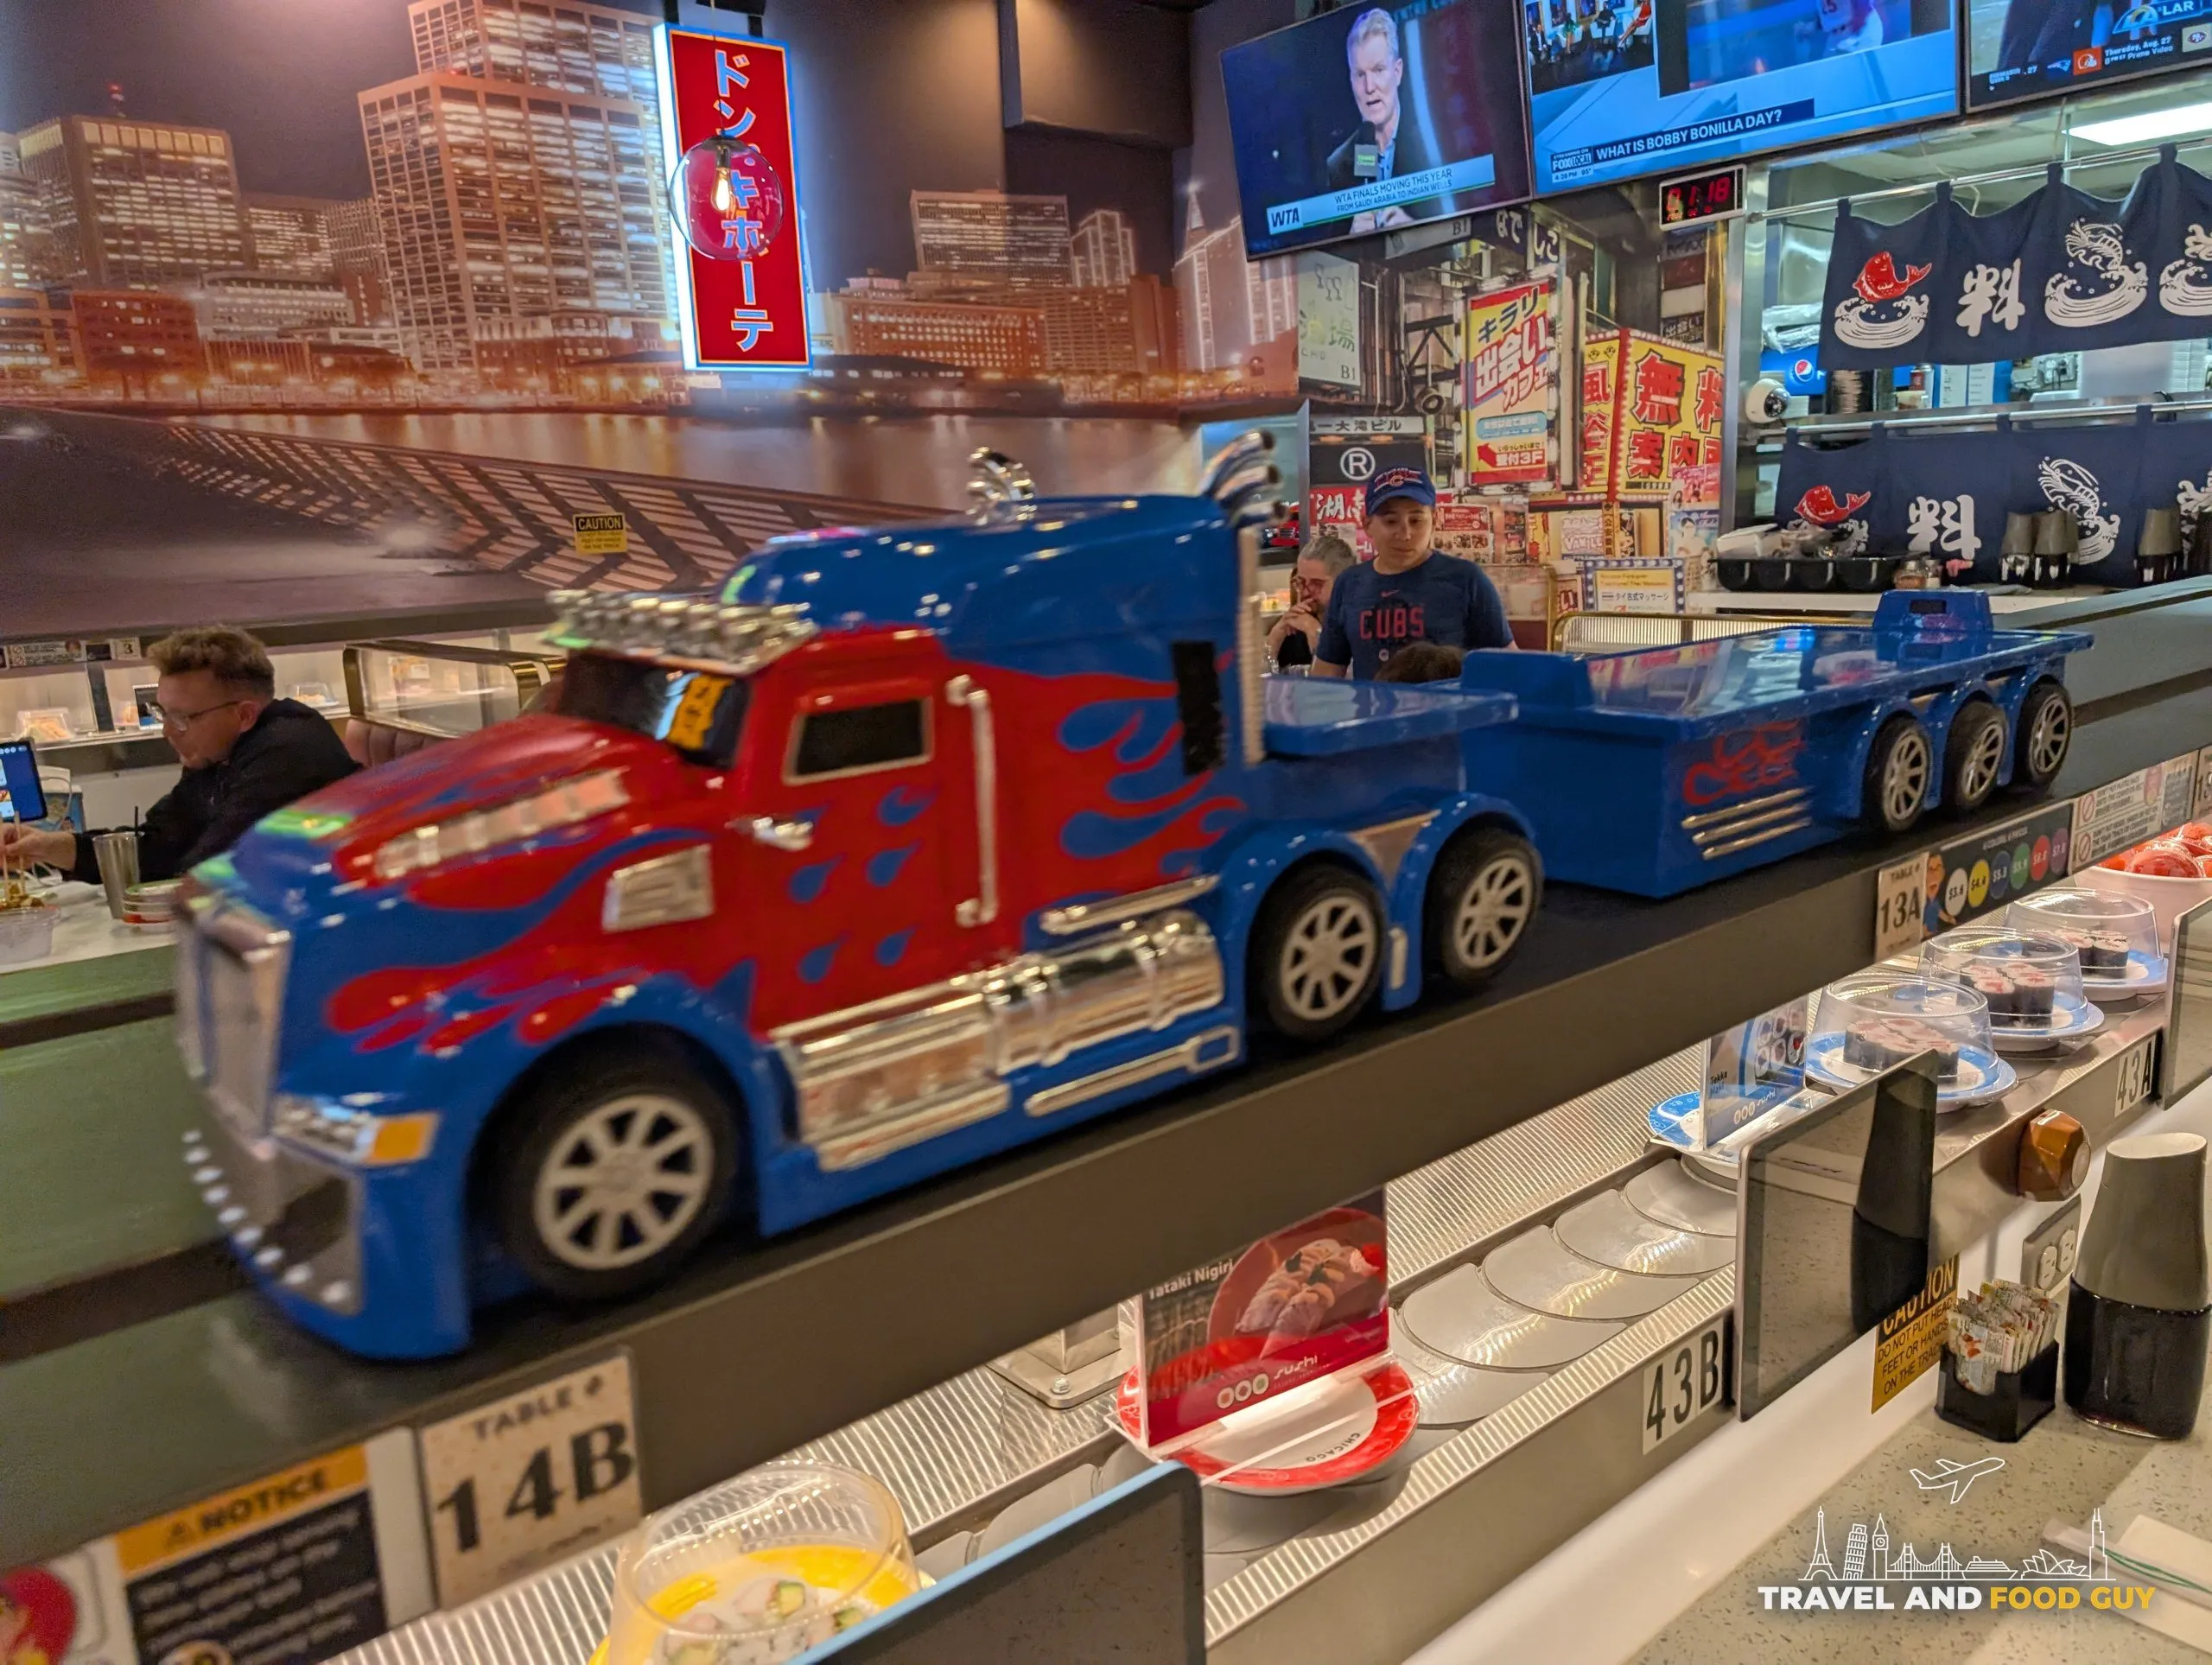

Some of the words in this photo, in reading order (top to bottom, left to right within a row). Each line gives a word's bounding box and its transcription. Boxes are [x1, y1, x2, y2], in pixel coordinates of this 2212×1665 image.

[2162, 0, 2195, 16] LAR
[1596, 143, 1631, 161] WHAT
[1632, 139, 1645, 153] IS
[1646, 130, 1688, 149] BOBBY
[1690, 118, 1743, 141] BONILLA
[1745, 109, 1783, 129] DAY?
[1334, 191, 1352, 204] WTA
[1353, 186, 1379, 201] FINALS
[1380, 178, 1411, 193] MOVING
[1413, 174, 1430, 185] THIS
[1431, 168, 1452, 181] YEAR
[1552, 158, 1572, 171] FOX
[1271, 207, 1300, 228] WTA
[1337, 202, 1355, 213] FROM
[1355, 199, 1373, 208] SAUDI
[1374, 194, 1396, 205] ARABIA
[1408, 186, 1430, 196] INDIAN
[1431, 179, 1452, 190] WELLS
[1478, 286, 1540, 344] キラリ
[1340, 365, 1356, 380] B1
[1476, 313, 1548, 400] 出会い
[1503, 359, 1550, 413] カフェ
[577, 517, 621, 530] CAUTION
[1359, 607, 1425, 639] CUBS
[1880, 887, 1921, 935] 13A
[1711, 1071, 1728, 1085] Tekka
[2117, 1040, 2152, 1111] 43A
[1194, 1258, 1236, 1284] Nigiri
[1878, 1344, 1891, 1363] DO
[1892, 1327, 1911, 1352] NOT
[1912, 1313, 1929, 1339] PUT
[1882, 1350, 1906, 1379] FEET
[1905, 1339, 1919, 1360] OR
[1920, 1321, 1949, 1348] HANDS
[1274, 1353, 1319, 1381] sushi
[1645, 1329, 1719, 1442] 43B
[1884, 1375, 1898, 1395] ON
[1900, 1360, 1916, 1381] THE
[1918, 1344, 1940, 1367] TRAC
[476, 1385, 573, 1440] TABLE
[1305, 1431, 1362, 1463] CHICAGO
[200, 1466, 326, 1535] NOTICE
[436, 1421, 633, 1553] 14B
